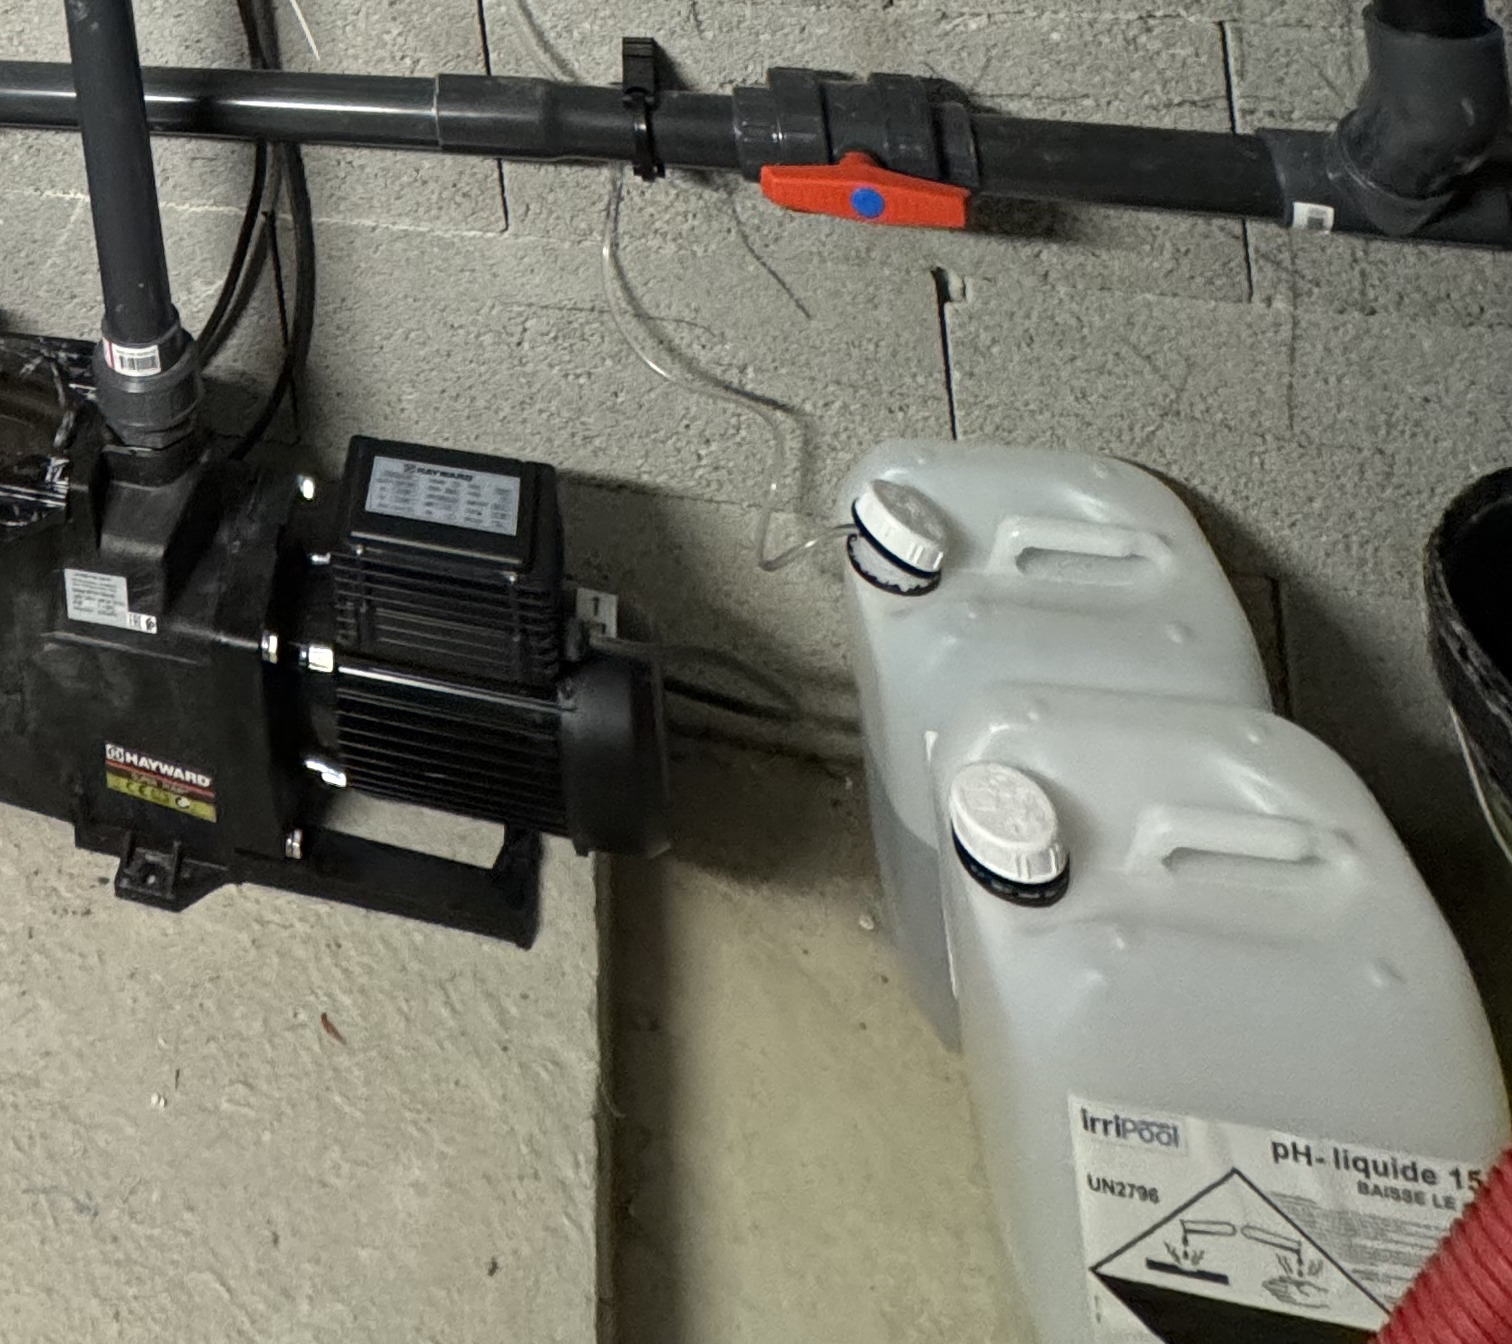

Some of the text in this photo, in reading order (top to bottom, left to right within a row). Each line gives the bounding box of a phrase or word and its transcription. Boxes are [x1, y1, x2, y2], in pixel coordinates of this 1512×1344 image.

[125, 751, 212, 788] HAYWARD
[1332, 1147, 1438, 1186] liquide
[1356, 1179, 1457, 1211] BAISSE LE
